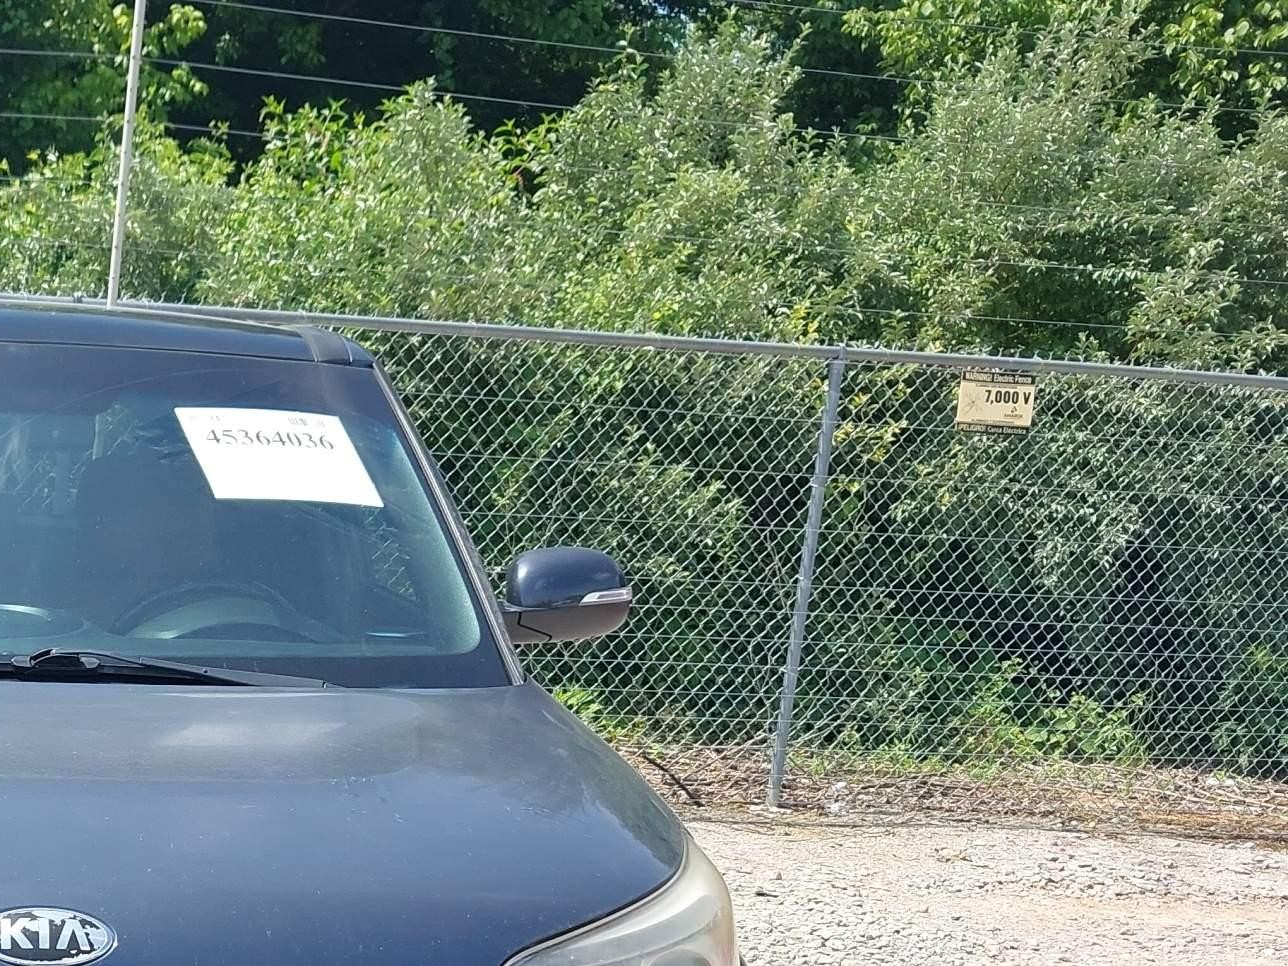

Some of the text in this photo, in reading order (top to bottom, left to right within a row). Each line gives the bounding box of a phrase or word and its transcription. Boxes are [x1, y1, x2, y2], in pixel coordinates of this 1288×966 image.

[985, 390, 1031, 405] 7,000 V
[206, 428, 334, 450] 45364036
[0, 917, 90, 950] KIA
